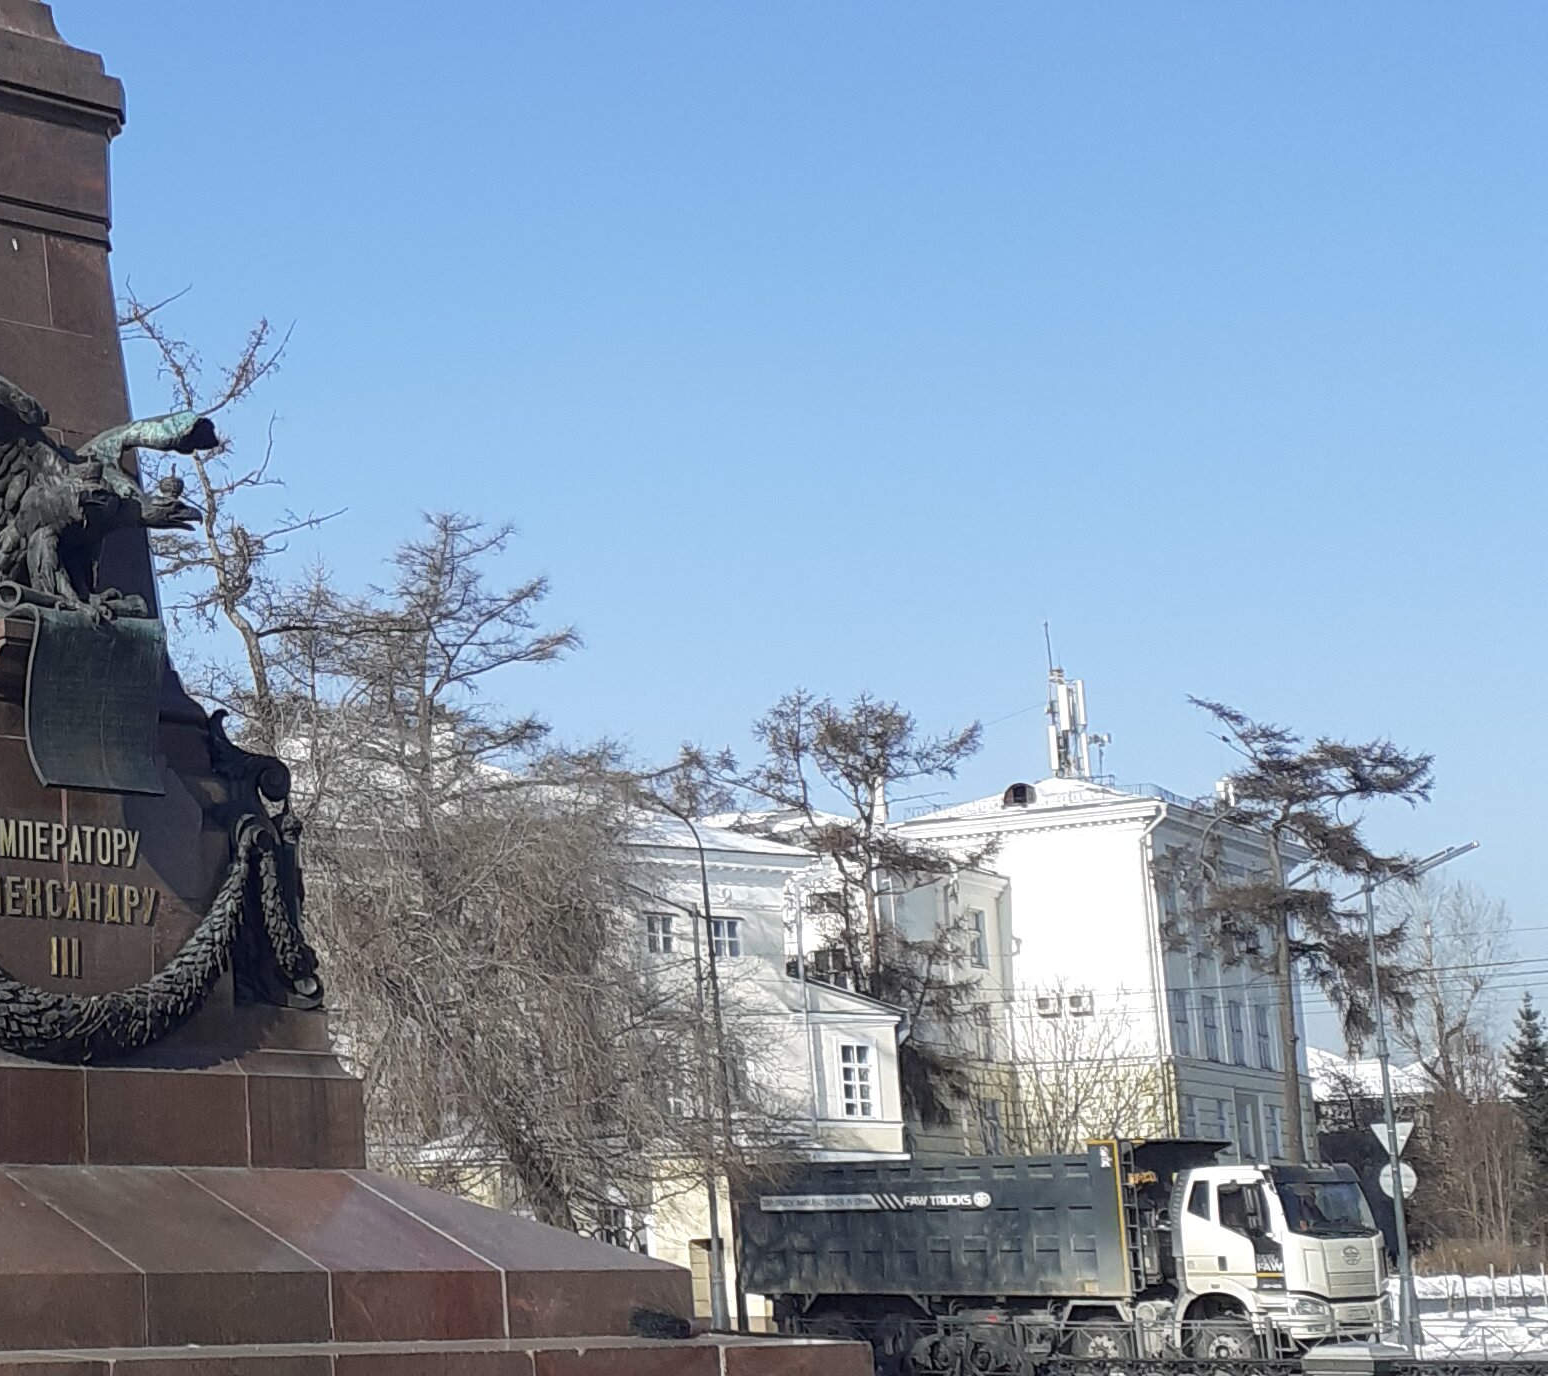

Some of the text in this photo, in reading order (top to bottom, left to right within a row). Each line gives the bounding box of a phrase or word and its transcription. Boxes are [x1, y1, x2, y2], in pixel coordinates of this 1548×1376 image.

[902, 1194, 972, 1207] FAW TRUCKS
[1257, 1262, 1283, 1272] FAW
